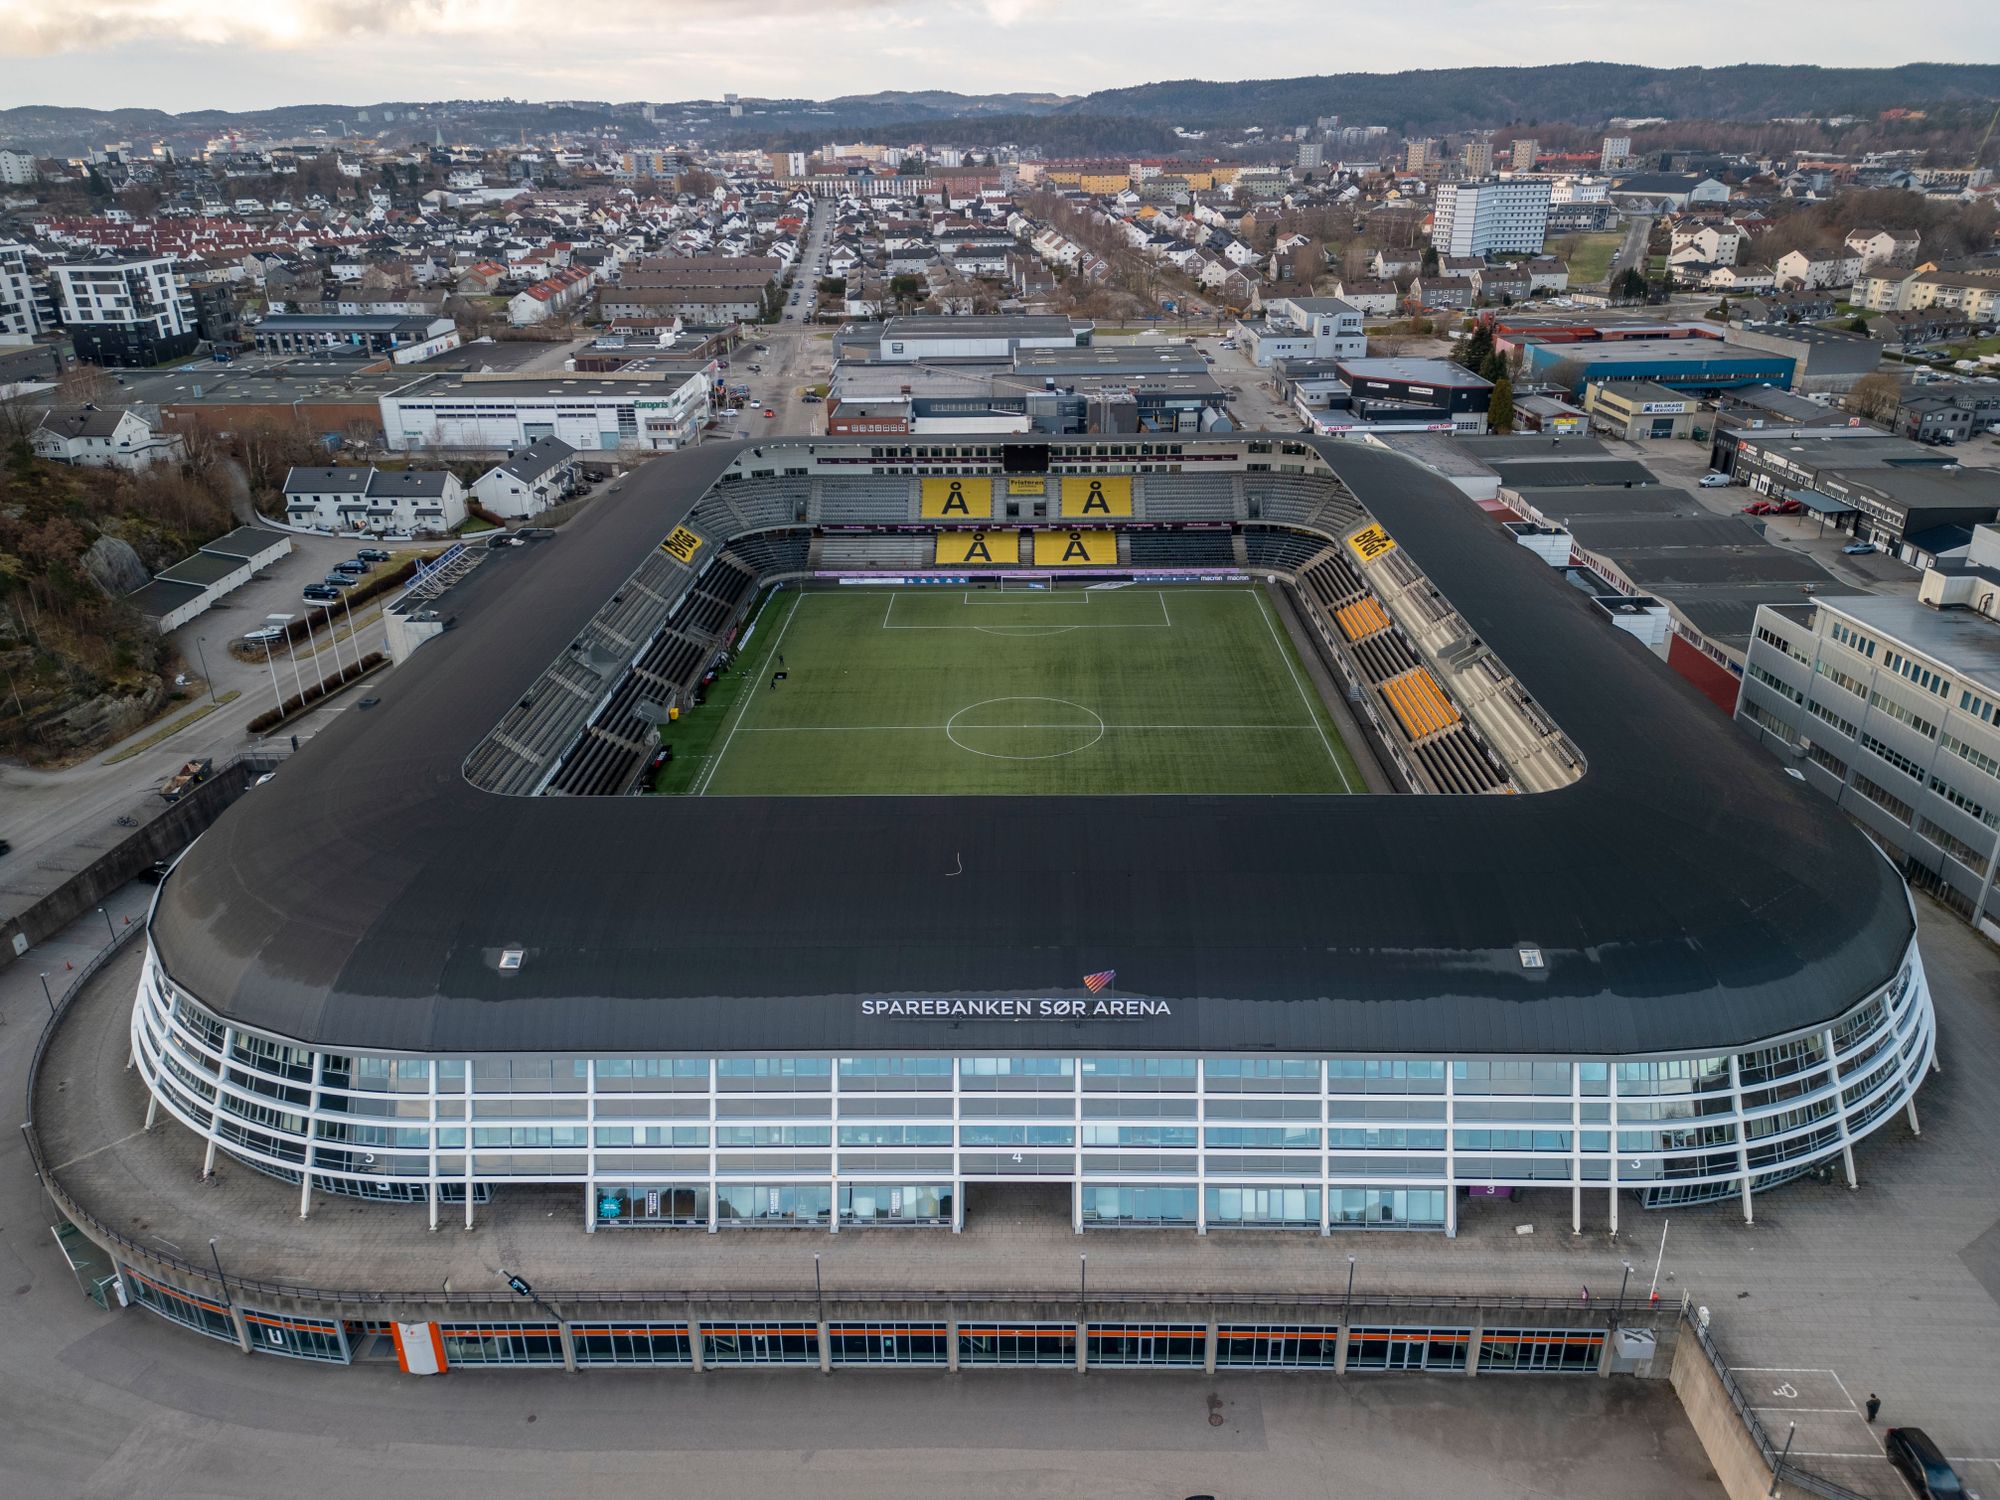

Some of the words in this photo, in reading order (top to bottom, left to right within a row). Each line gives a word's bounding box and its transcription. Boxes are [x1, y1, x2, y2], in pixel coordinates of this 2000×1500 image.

[634, 400, 669, 411] Europris
[941, 481, 970, 515] Å
[1082, 481, 1111, 514] Å
[963, 533, 992, 562] Å
[1062, 532, 1091, 561] Å
[861, 1000, 1032, 1016] SPAREBANKEN
[1039, 1000, 1086, 1016] SØR
[1093, 1000, 1171, 1016] ARENA
[1012, 1153, 1023, 1163] 4
[1631, 1158, 1641, 1169] 3
